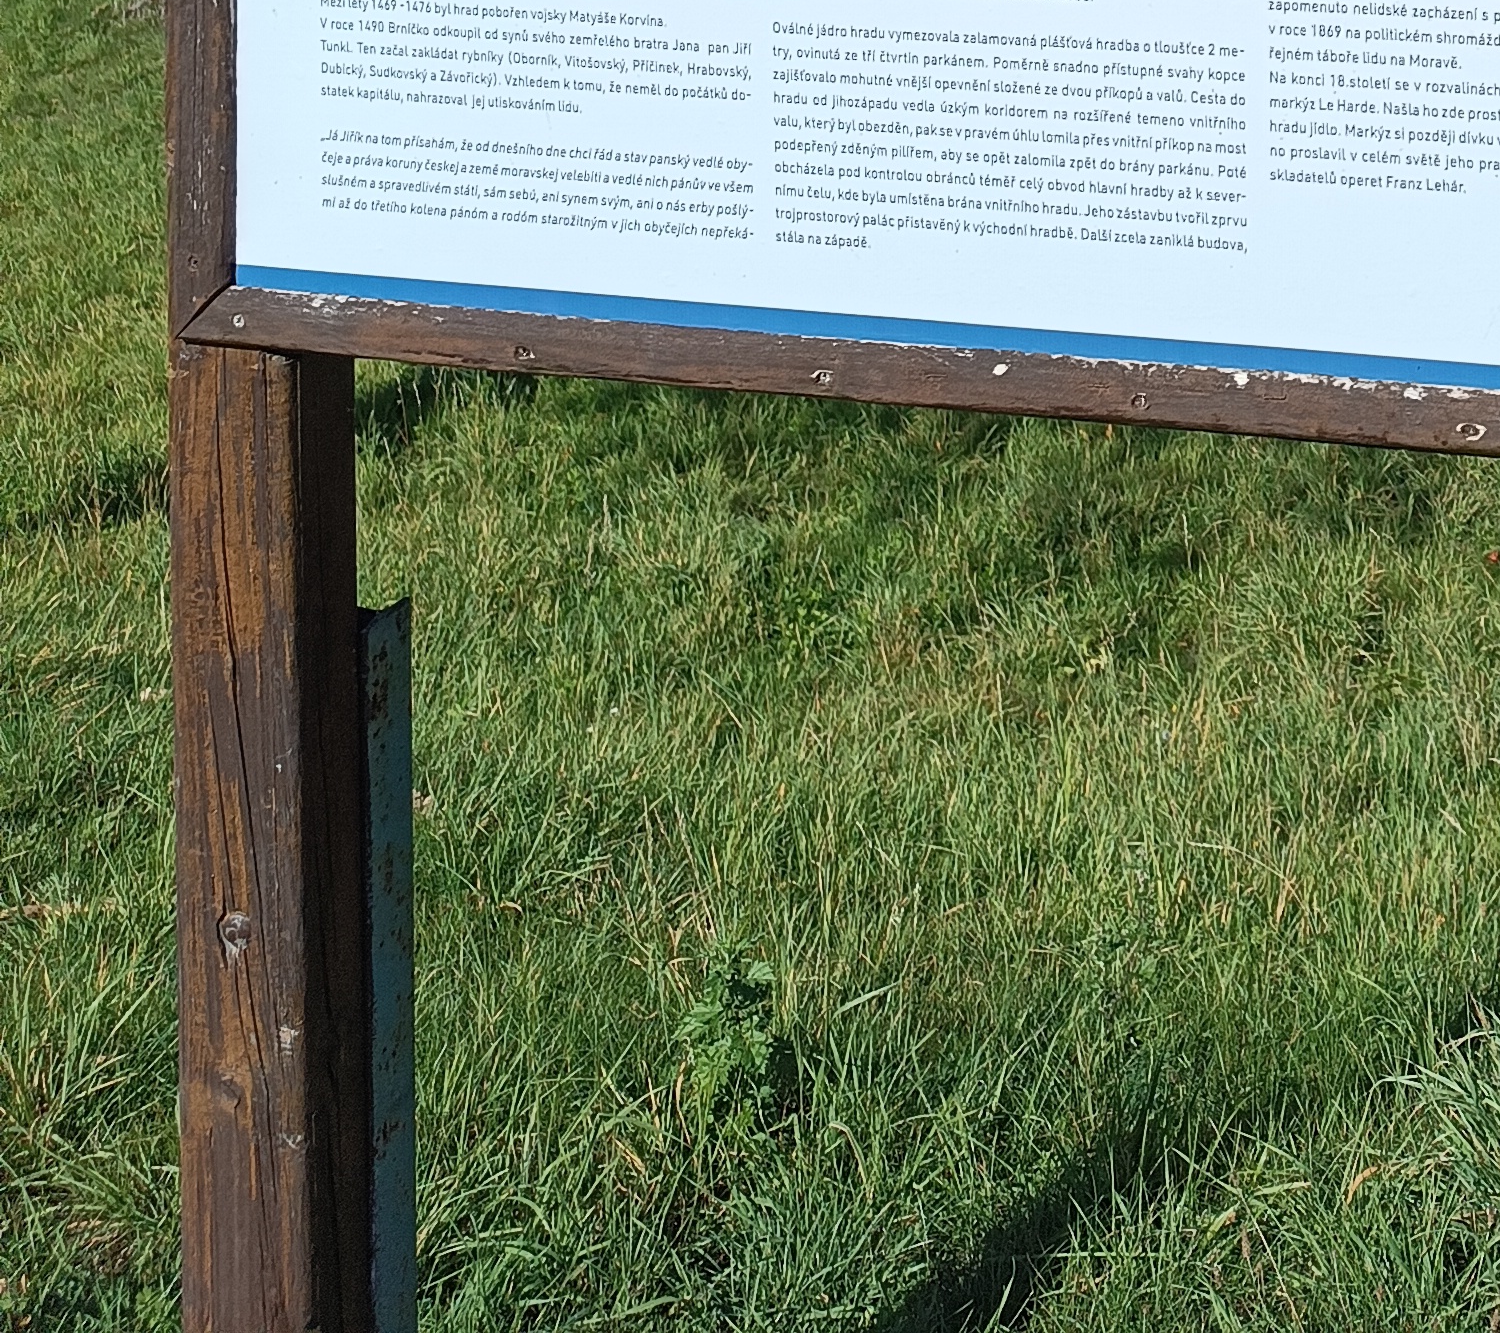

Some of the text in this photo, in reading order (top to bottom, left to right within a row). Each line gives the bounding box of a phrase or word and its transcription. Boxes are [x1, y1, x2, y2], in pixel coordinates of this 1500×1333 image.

[434, 1, 452, 18] byl
[453, 3, 479, 17] hrad
[481, 5, 529, 20] pobořen
[529, 8, 567, 25] vojsky
[569, 9, 617, 27] Matyáše
[356, 41, 377, 55] Ten
[379, 44, 410, 57] začal
[411, 46, 459, 61] zakládat
[461, 49, 504, 66] rybníky
[632, 59, 683, 77] Příčinek,
[687, 62, 752, 82] Hrabovský,
[774, 138, 839, 157] podepřený
[840, 141, 888, 159] zděným
[891, 144, 937, 163] pilířem,
[940, 147, 963, 165] aby
[965, 151, 980, 163] se
[982, 151, 1011, 167] opět
[1013, 152, 1066, 168] zalomila
[1069, 156, 1097, 172] zpět
[1099, 157, 1116, 171] do
[1119, 158, 1155, 177] brány
[1157, 161, 1214, 178] parkánu.
[1269, 146, 1286, 158] no
[1289, 146, 1347, 162] proslavil
[1349, 151, 1358, 162] v
[1361, 150, 1401, 165] celém
[1405, 152, 1441, 167] světě
[1443, 154, 1474, 171] jeho
[1269, 168, 1467, 194] skladatelů operet Franz Lehár.
